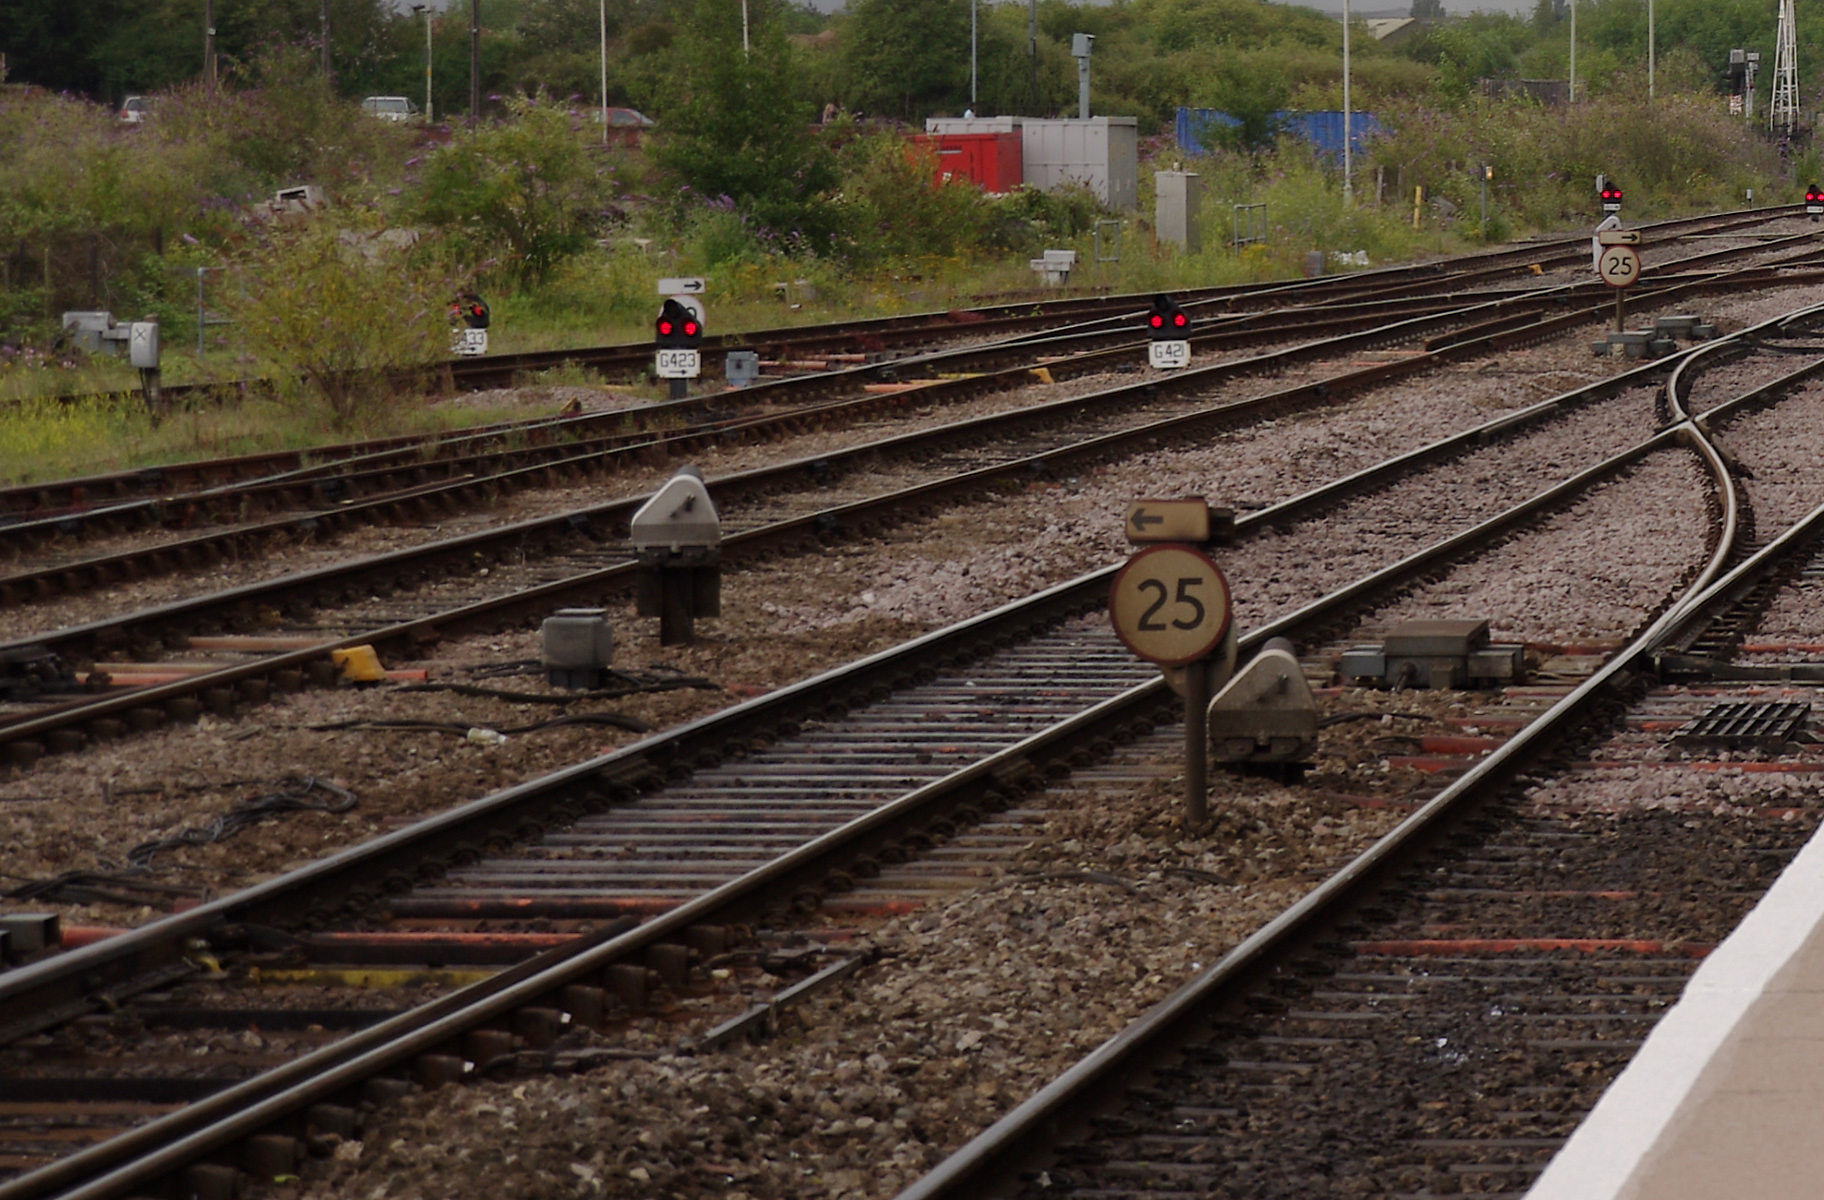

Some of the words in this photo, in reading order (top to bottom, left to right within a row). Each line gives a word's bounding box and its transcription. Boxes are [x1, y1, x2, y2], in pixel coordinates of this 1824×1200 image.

[1608, 256, 1633, 276] 25
[659, 352, 696, 368] G423
[1154, 343, 1185, 359] G421
[1137, 578, 1206, 632] 25
